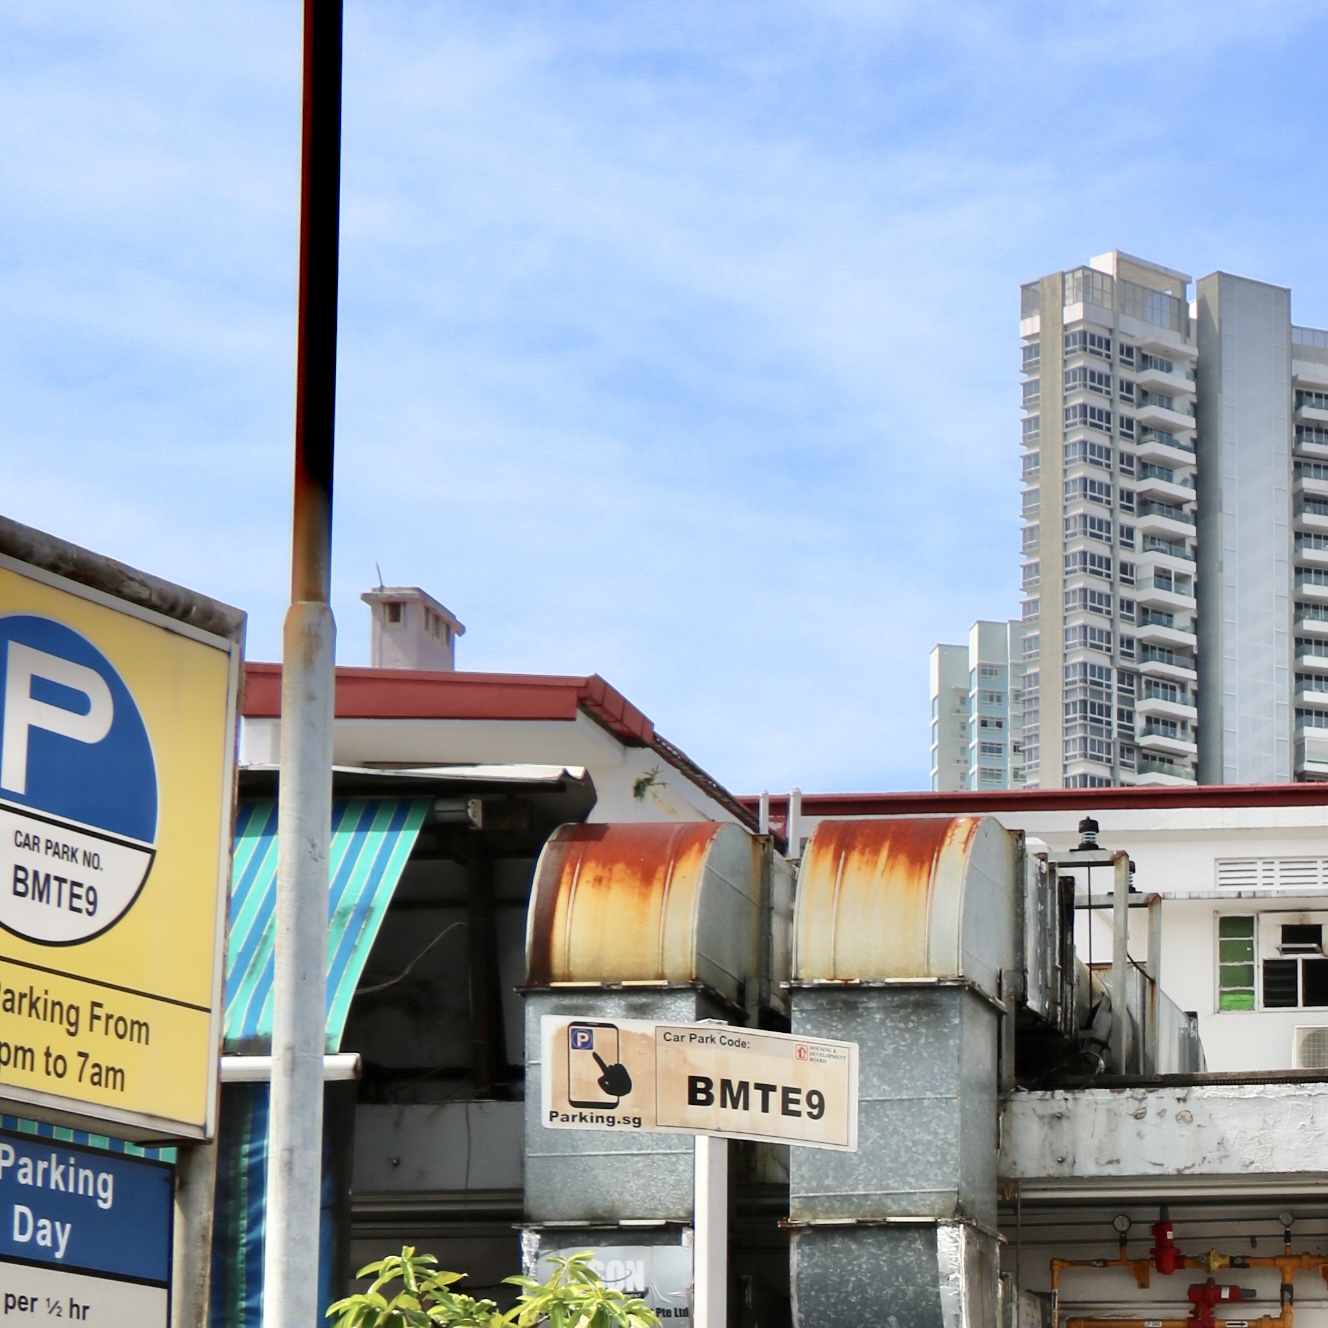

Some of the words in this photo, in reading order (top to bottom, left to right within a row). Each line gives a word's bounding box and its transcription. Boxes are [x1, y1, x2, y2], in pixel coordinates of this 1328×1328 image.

[2, 639, 114, 795] P
[14, 830, 41, 853] CAR
[45, 838, 79, 865] PARK
[82, 850, 104, 871] NO.
[12, 864, 99, 917] BMTE9
[0, 984, 80, 1037] arking
[89, 1000, 150, 1046] From
[663, 1031, 686, 1043] Car
[689, 1033, 716, 1046] Park
[719, 1035, 751, 1049] Code:
[44, 1045, 68, 1079] to
[76, 1051, 125, 1092] 7am
[549, 1110, 642, 1128] Parking.sg
[687, 1075, 826, 1120] BMTE9
[0, 1143, 114, 1210] Parking
[13, 1204, 71, 1259] Day
[4, 1292, 38, 1315] per
[69, 1298, 91, 1321] hr
[656, 1307, 671, 1318] Pte
[674, 1307, 689, 1318] Ltd
